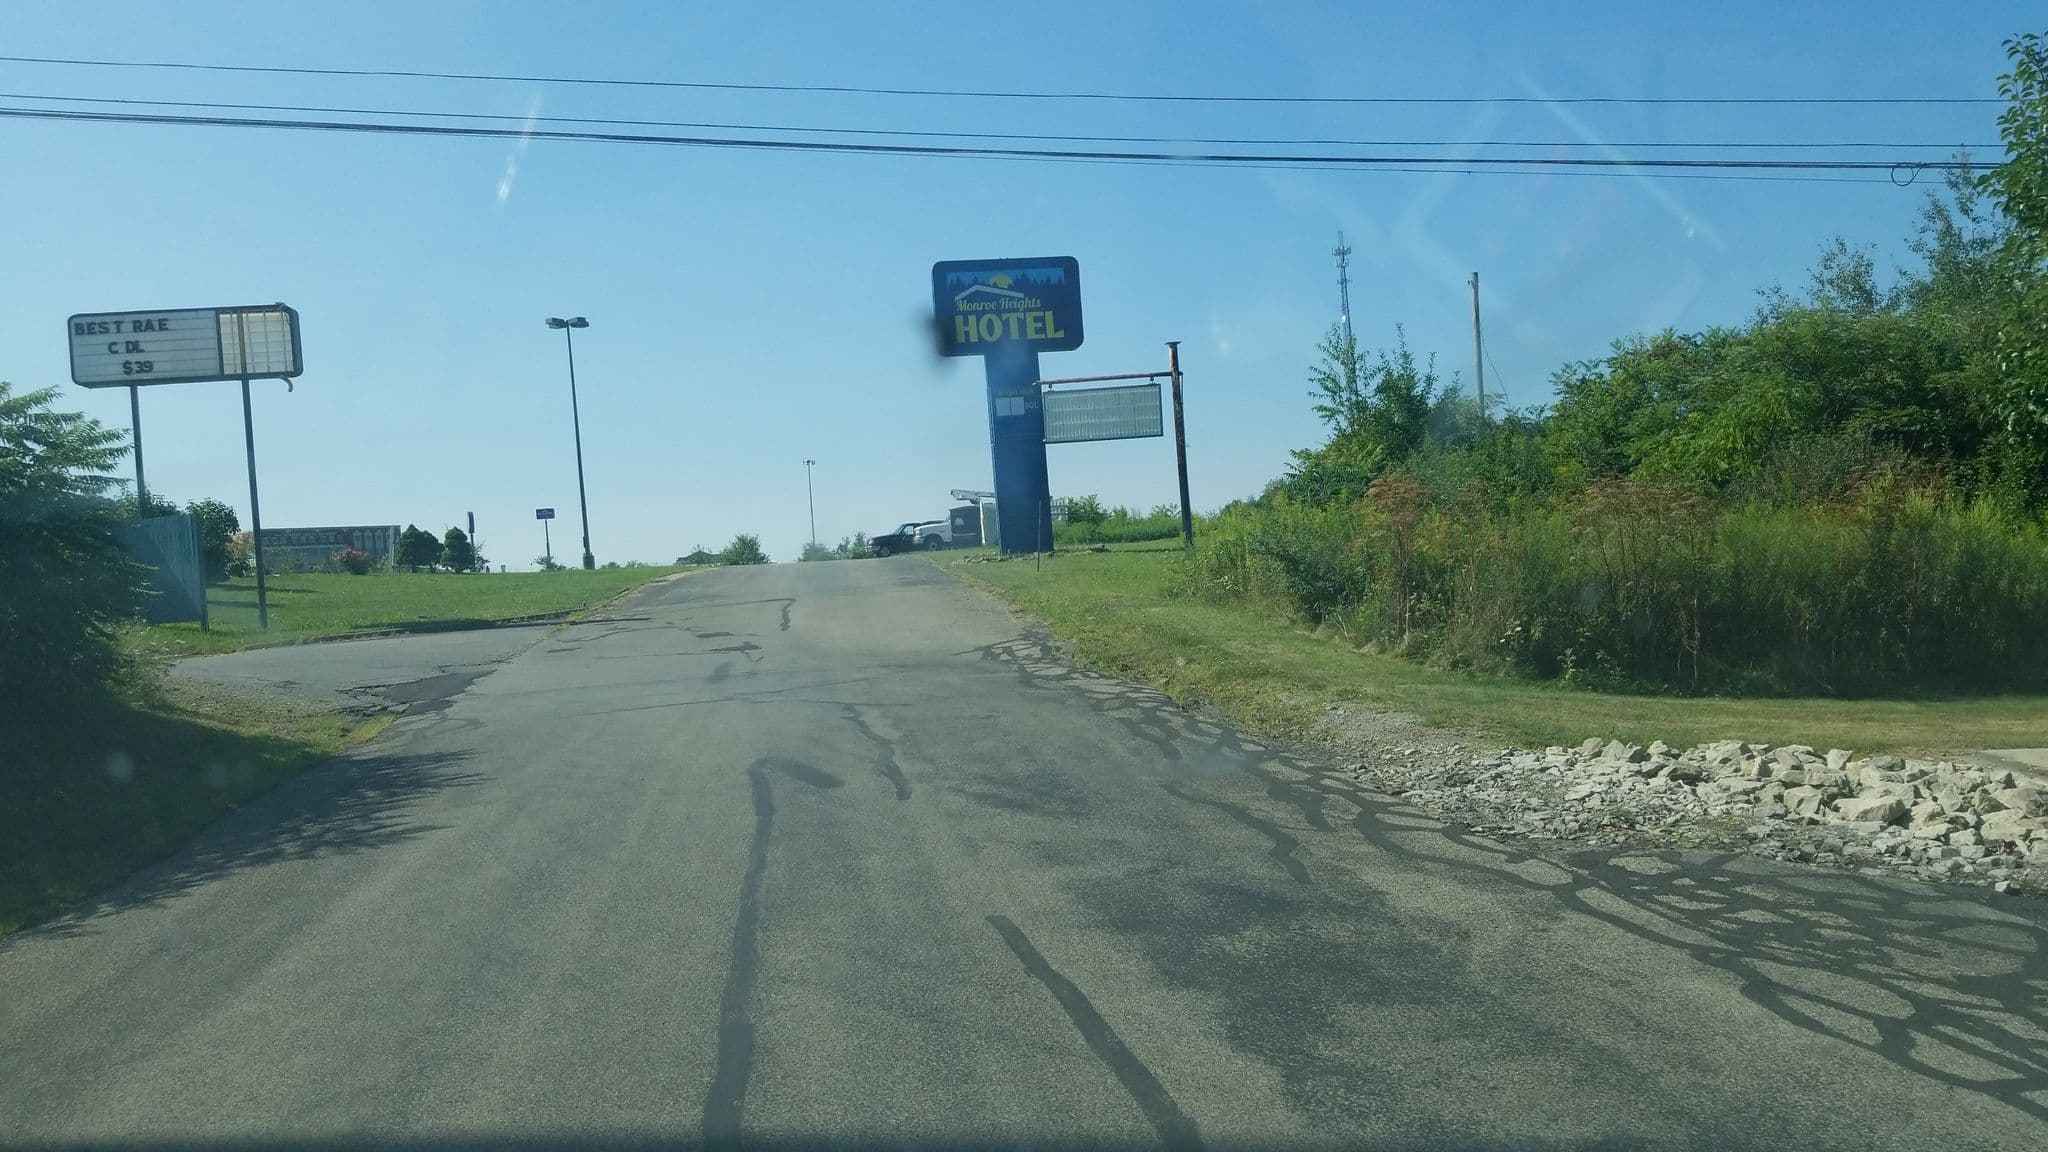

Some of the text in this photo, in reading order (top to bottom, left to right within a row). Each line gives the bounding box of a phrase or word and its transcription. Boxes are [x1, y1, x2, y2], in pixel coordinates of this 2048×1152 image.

[956, 297, 1041, 312] Monroe Heights
[74, 318, 169, 336] BEST RAE
[955, 312, 1064, 343] HOTEL
[122, 360, 154, 375] $39
